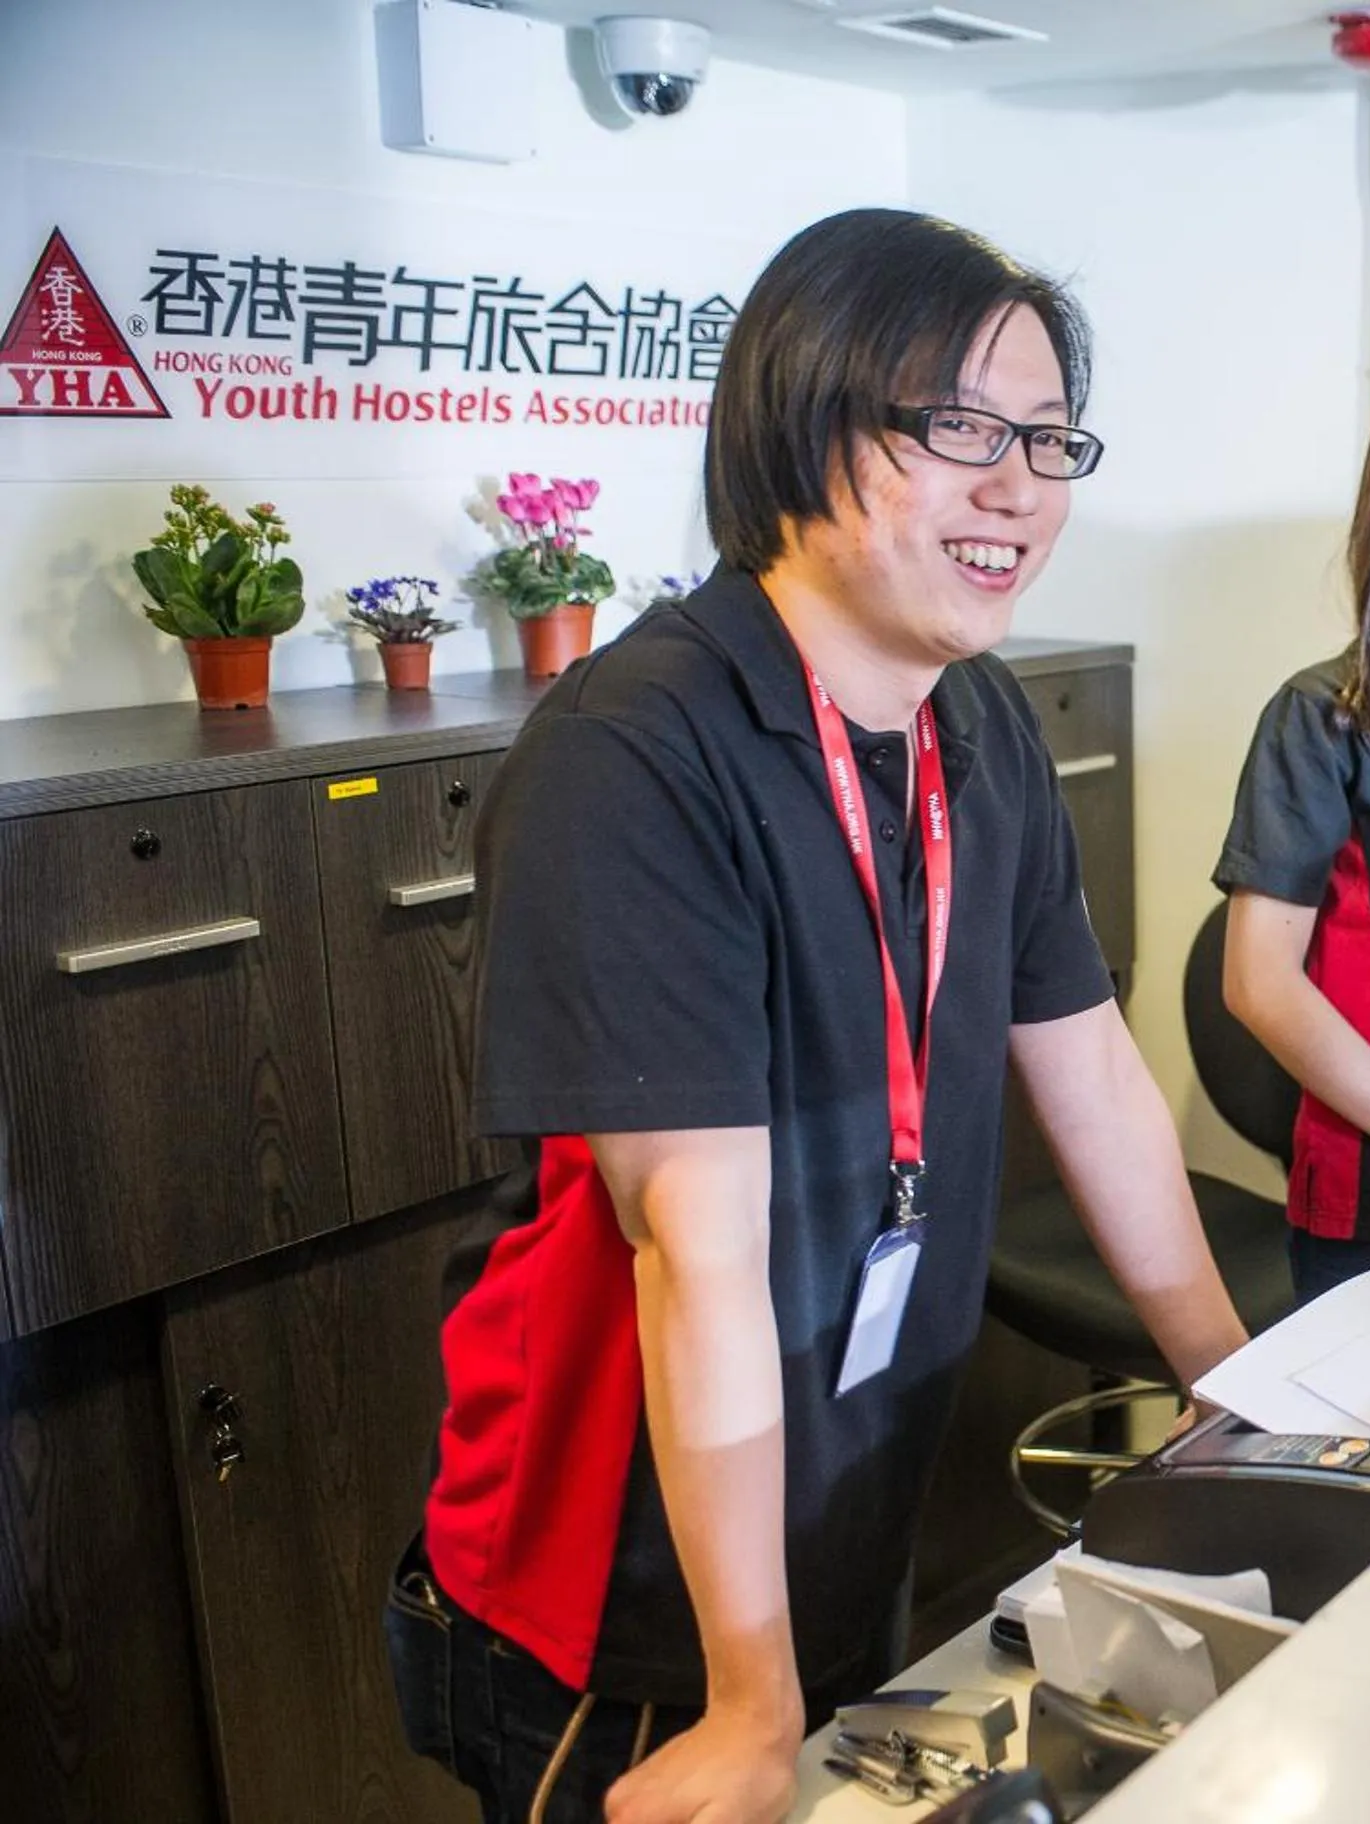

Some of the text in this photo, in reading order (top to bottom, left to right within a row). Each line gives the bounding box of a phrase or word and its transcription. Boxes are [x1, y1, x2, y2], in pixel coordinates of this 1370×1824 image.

[40, 266, 86, 346] 香港
[140, 249, 738, 381] 香港青年旅舍協會
[32, 349, 102, 361] HONG KONG
[154, 351, 293, 376] HONG KONG
[8, 368, 135, 407] YHA
[194, 376, 338, 420] Youth
[352, 383, 512, 424] Hostels
